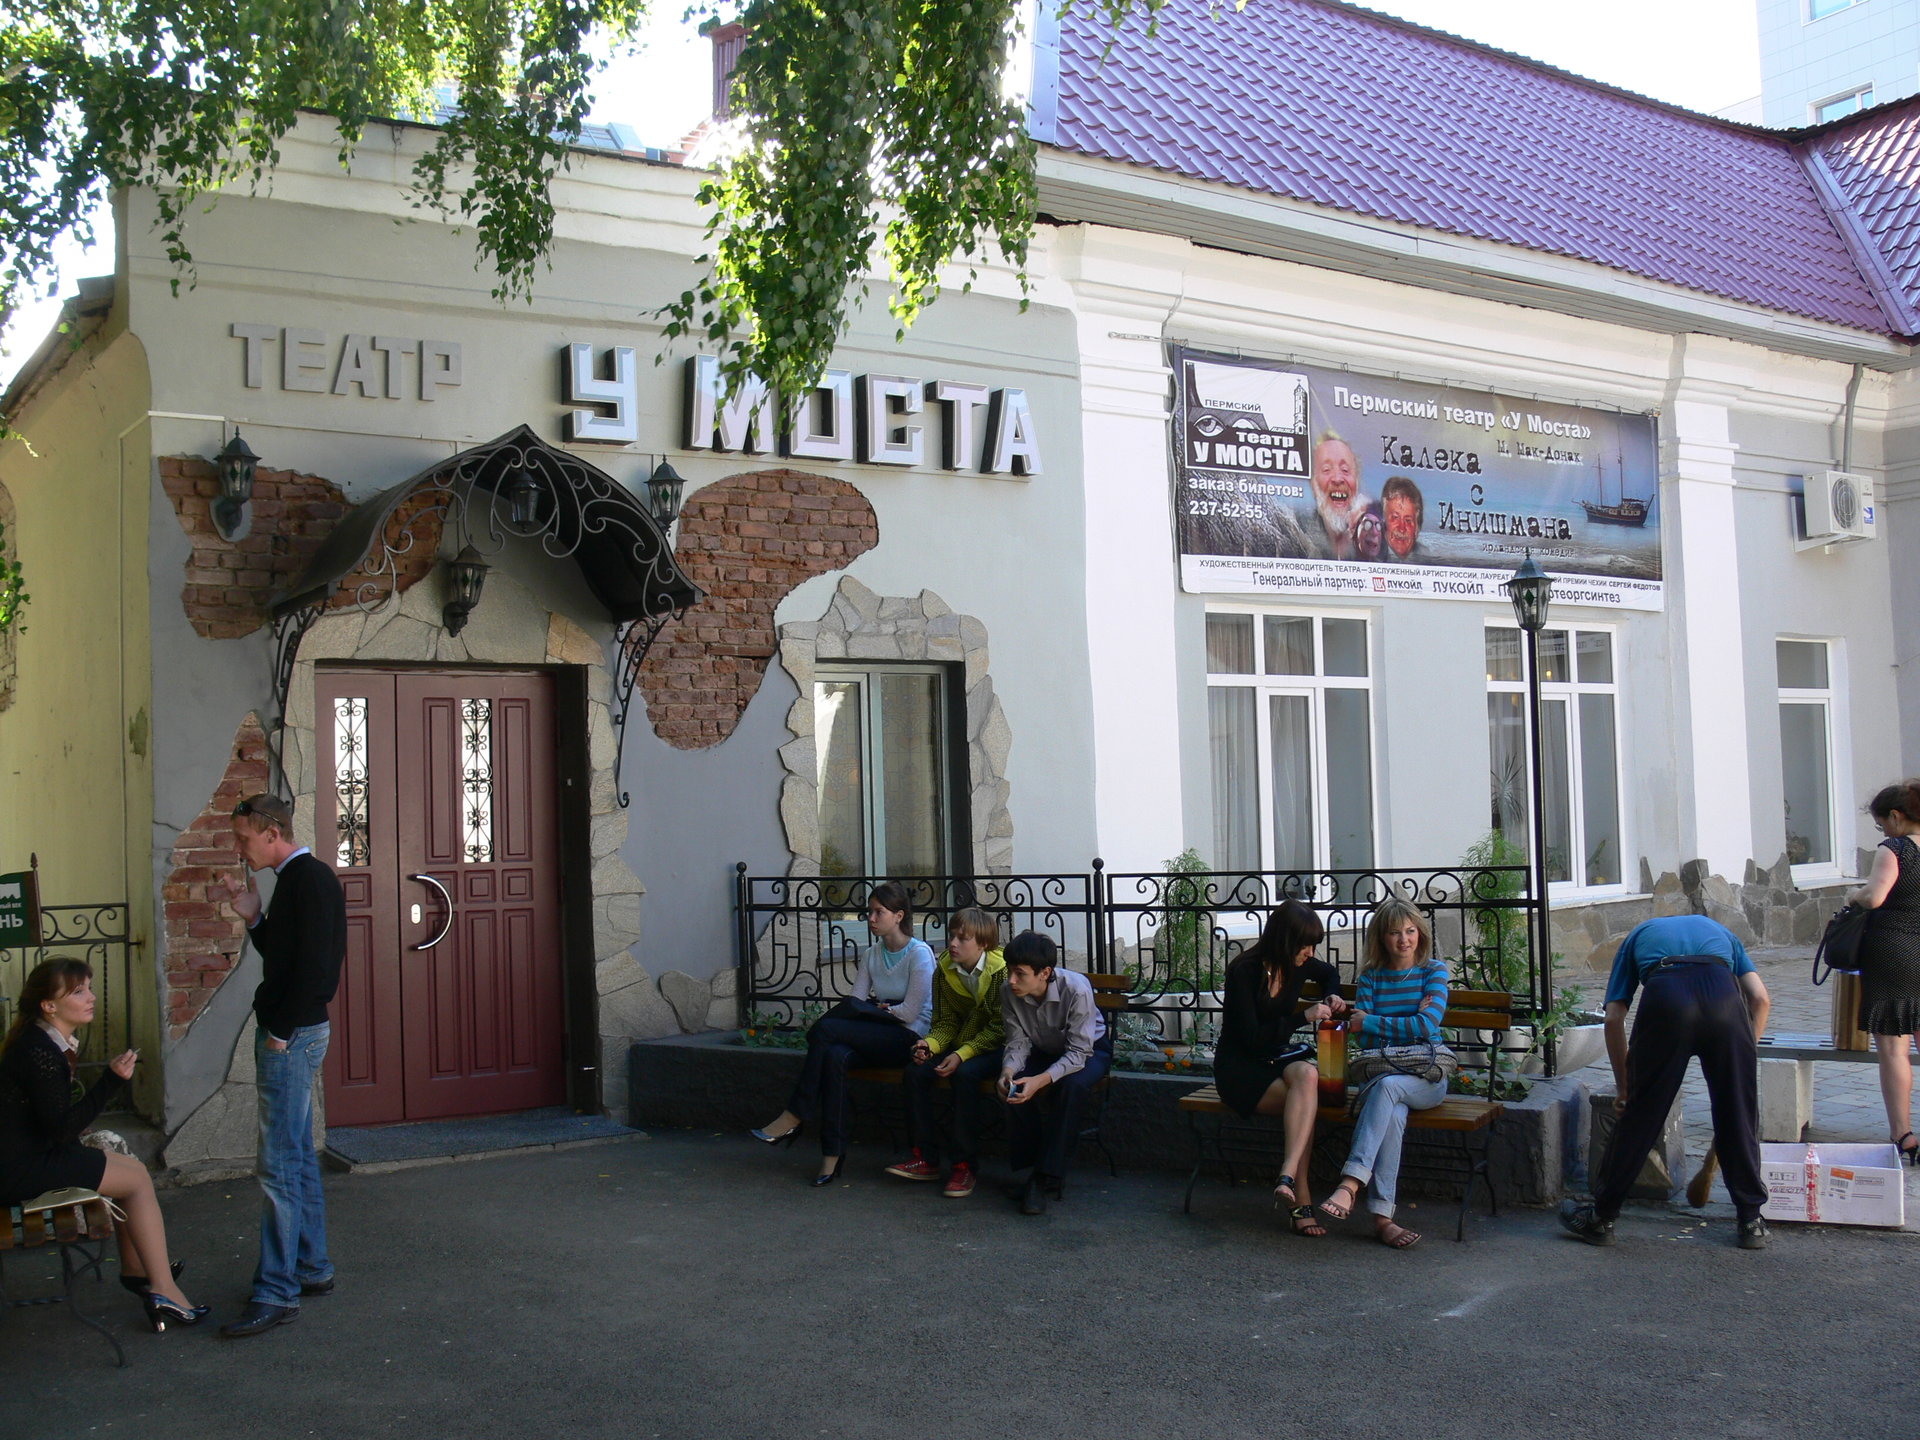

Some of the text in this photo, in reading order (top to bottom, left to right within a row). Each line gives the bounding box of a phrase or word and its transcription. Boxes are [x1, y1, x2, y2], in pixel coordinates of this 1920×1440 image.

[229, 322, 1043, 477] ТЕАТР У МОСТА
[1204, 398, 1262, 412] ПЕРМСКИЙ
[1333, 386, 1438, 419] Пермский
[1443, 404, 1496, 431] театр
[1527, 413, 1592, 440] Моста»
[1236, 431, 1295, 449] театр
[1193, 440, 1303, 472] У МОСТА
[1380, 435, 1482, 476] Калека
[1188, 478, 1304, 497] заказ билетов:
[1189, 500, 1264, 519] 237-52-55
[1438, 502, 1573, 541] Инишмана
[1199, 558, 1274, 570] ХУДОЖЕСТВЕННЫЙ
[1275, 562, 1334, 573] РУКОВОДИТЕЛЬ
[1422, 570, 1448, 578] АРТИСТ
[1480, 572, 1508, 581] ЛАУРЕАТ
[1252, 571, 1322, 589] Генеральный
[1324, 578, 1367, 590] партнер:
[1432, 580, 1485, 595] ЛУКОЙЛ
[1563, 577, 1588, 586] ПРЕМИИ
[1608, 580, 1632, 589] СЕРГЕЙ
[1632, 582, 1661, 592] ФЕДОТОВ
